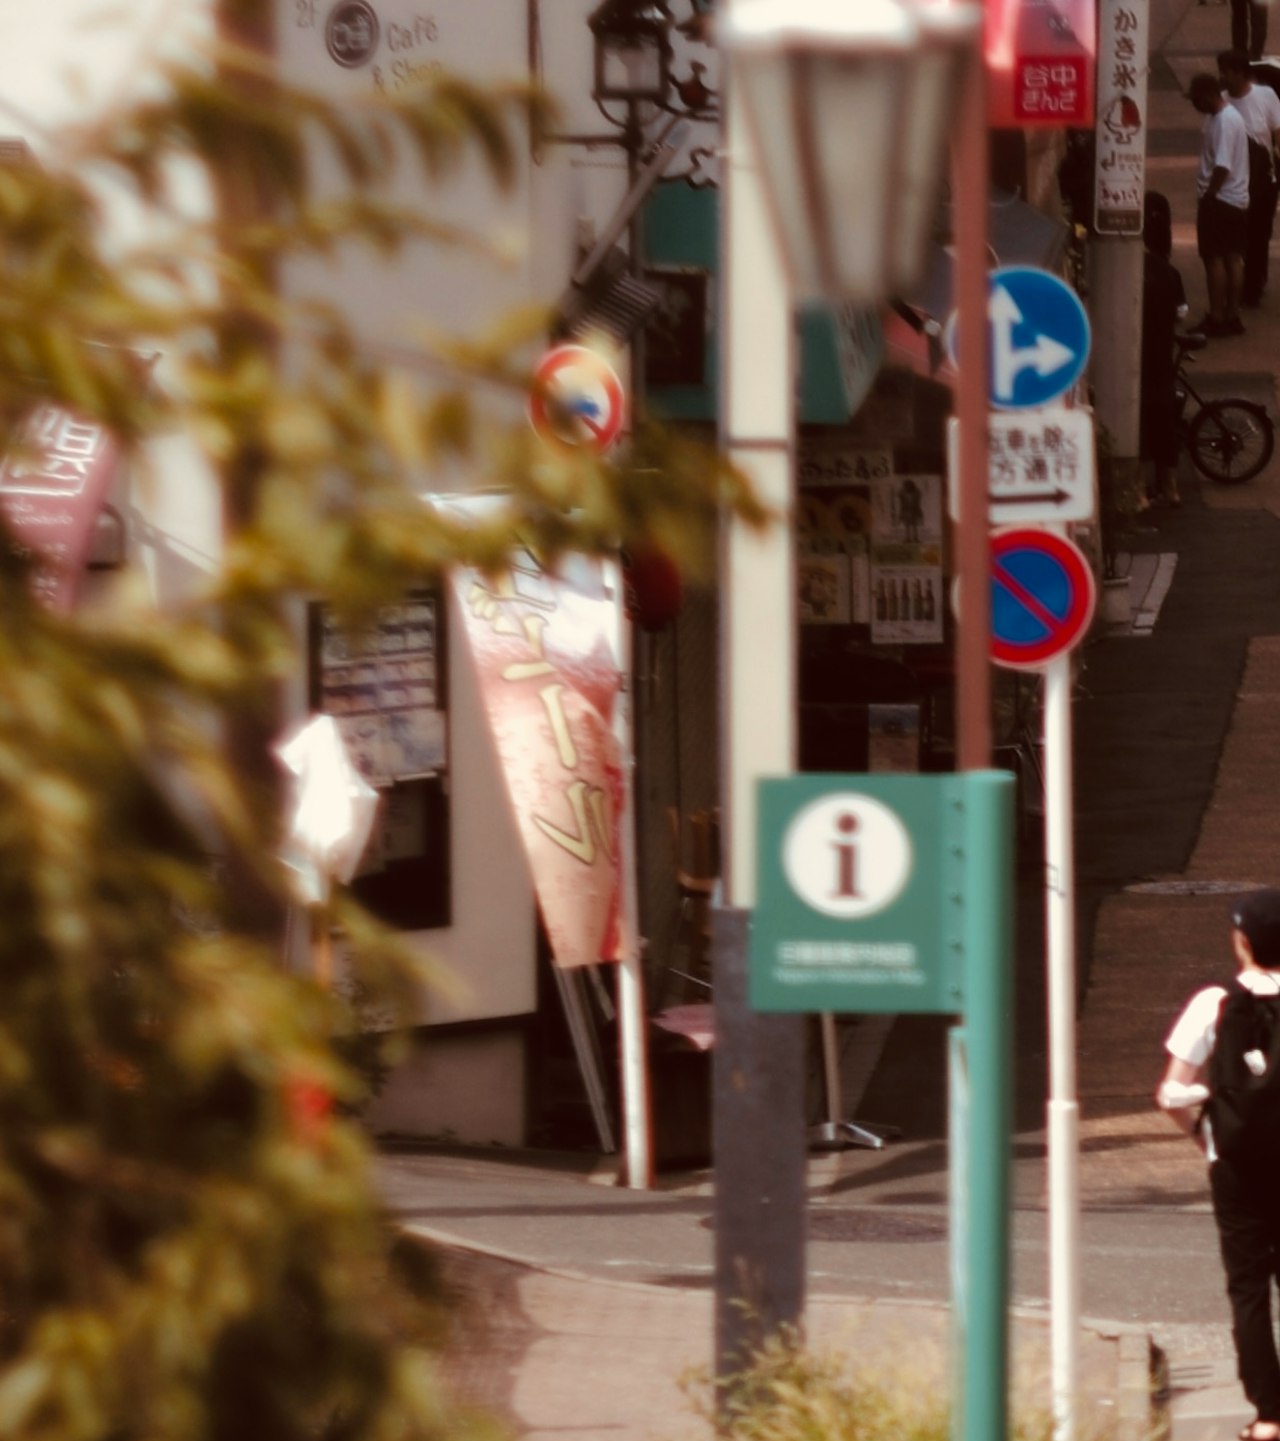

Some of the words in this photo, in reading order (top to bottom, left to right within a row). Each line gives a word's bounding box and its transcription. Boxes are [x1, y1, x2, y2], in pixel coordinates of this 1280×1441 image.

[1113, 10, 1138, 91] かき氷
[1023, 65, 1077, 88] 谷中
[1022, 89, 1078, 113] ぎんざ
